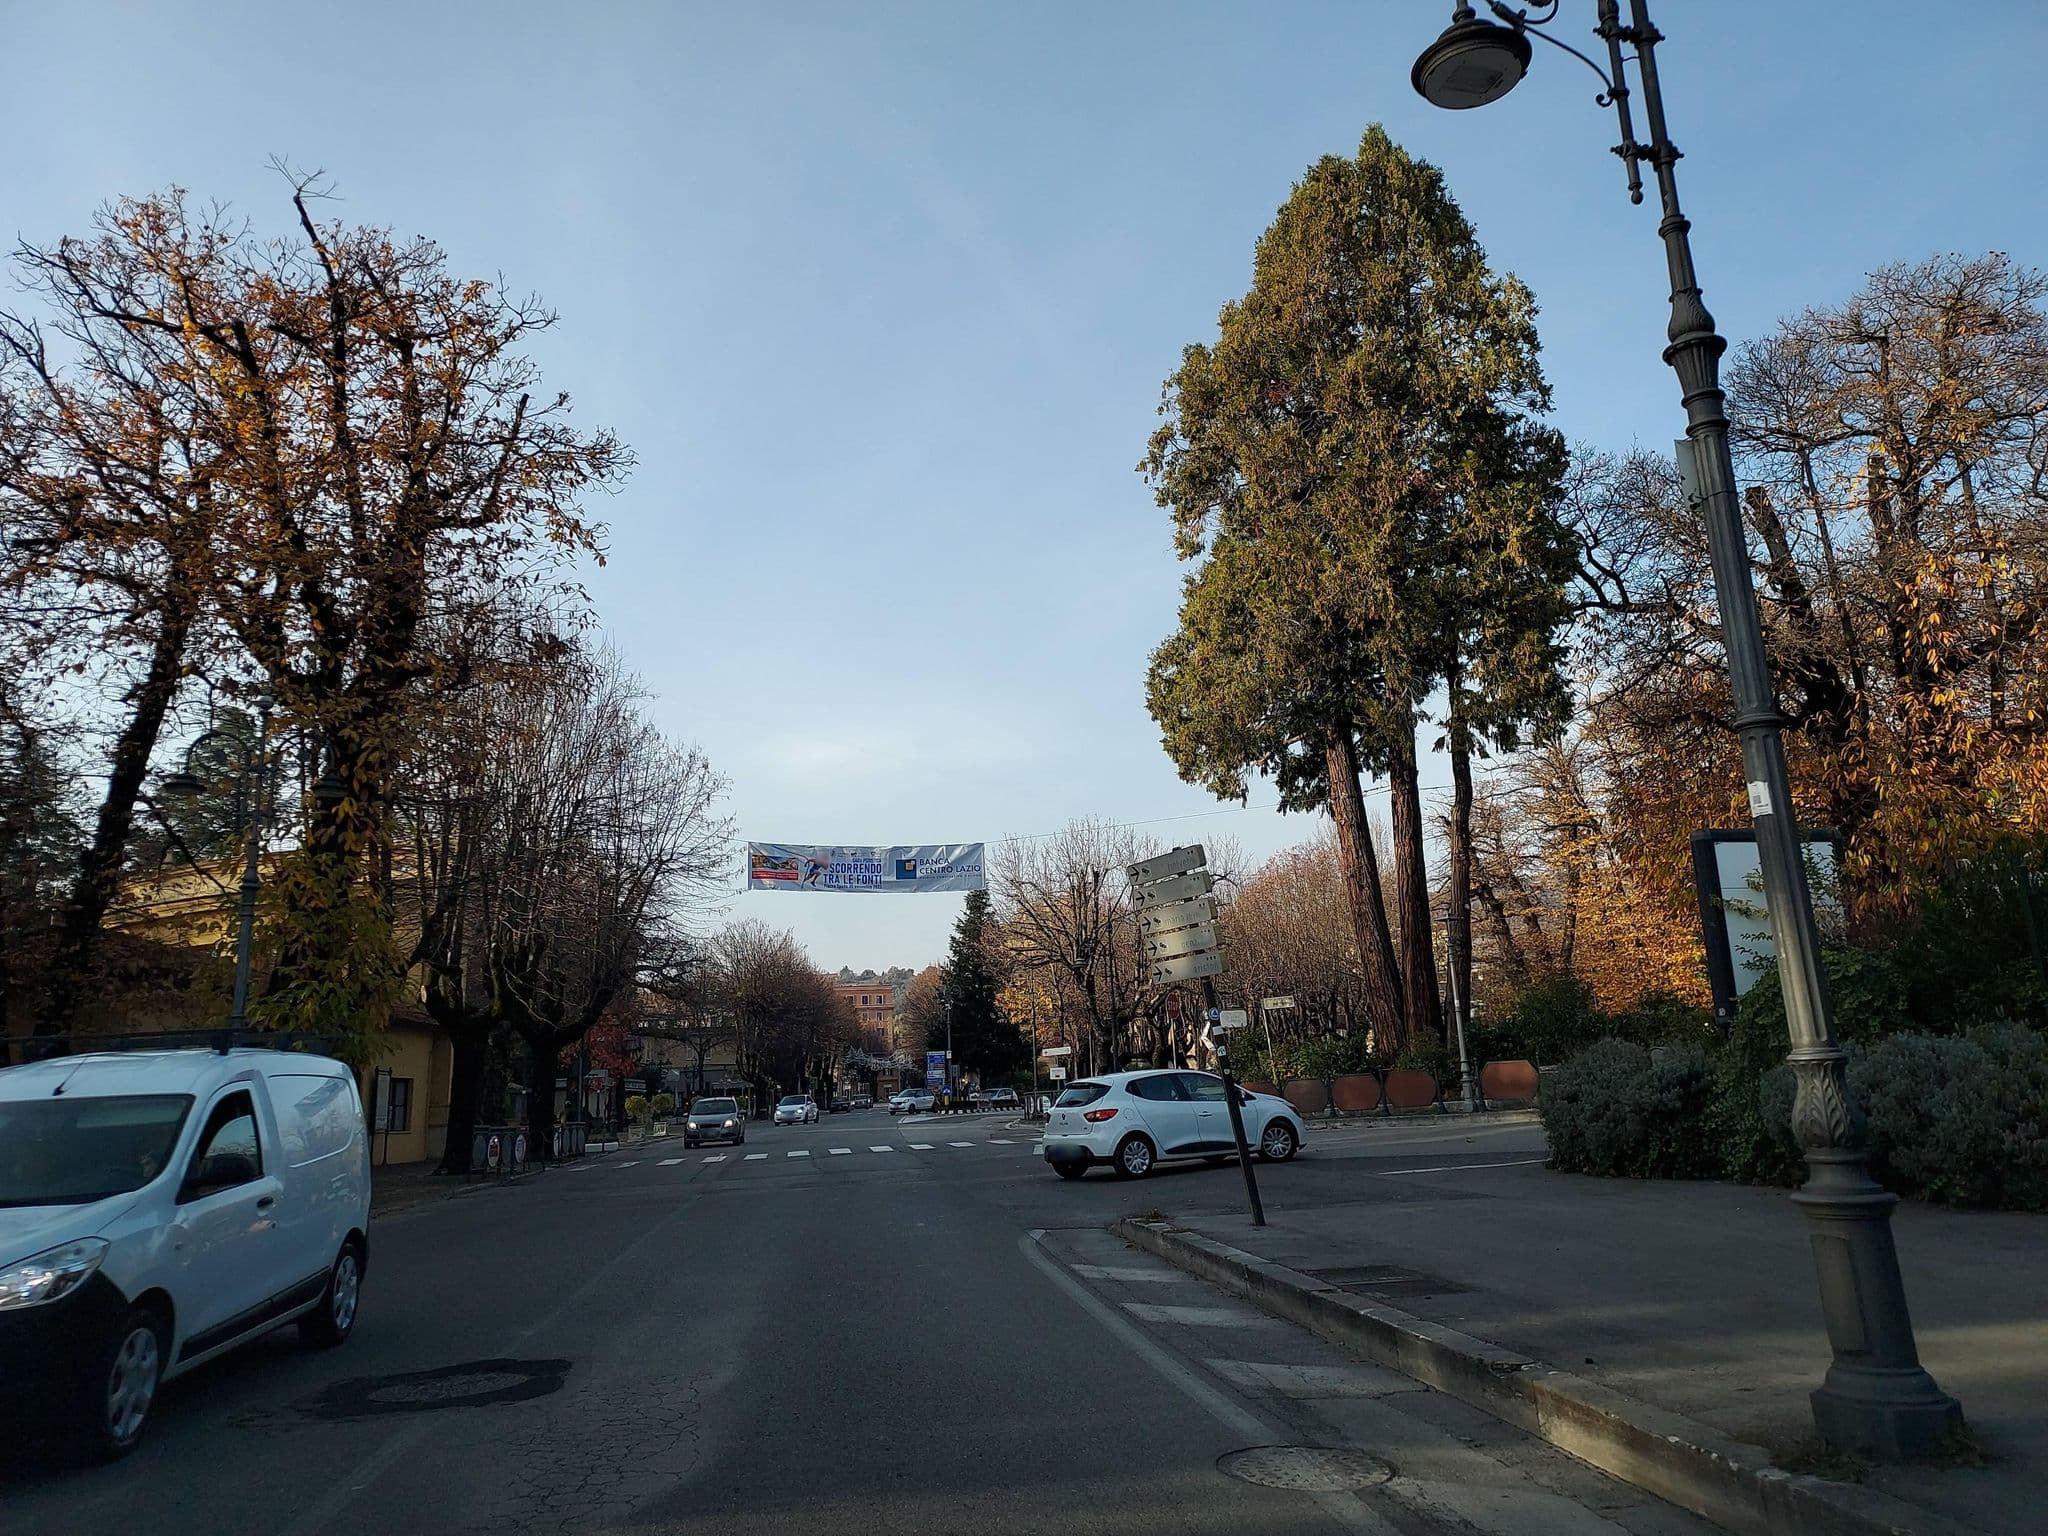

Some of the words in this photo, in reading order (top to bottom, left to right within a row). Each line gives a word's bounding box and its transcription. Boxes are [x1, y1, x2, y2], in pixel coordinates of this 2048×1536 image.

[830, 863, 882, 873] SCORRENDO
[920, 866, 953, 874] CENTRO
[956, 864, 981, 872] LAZIO
[824, 874, 839, 883] TRA
[844, 874, 853, 884] LE
[857, 875, 882, 884] FONTI
